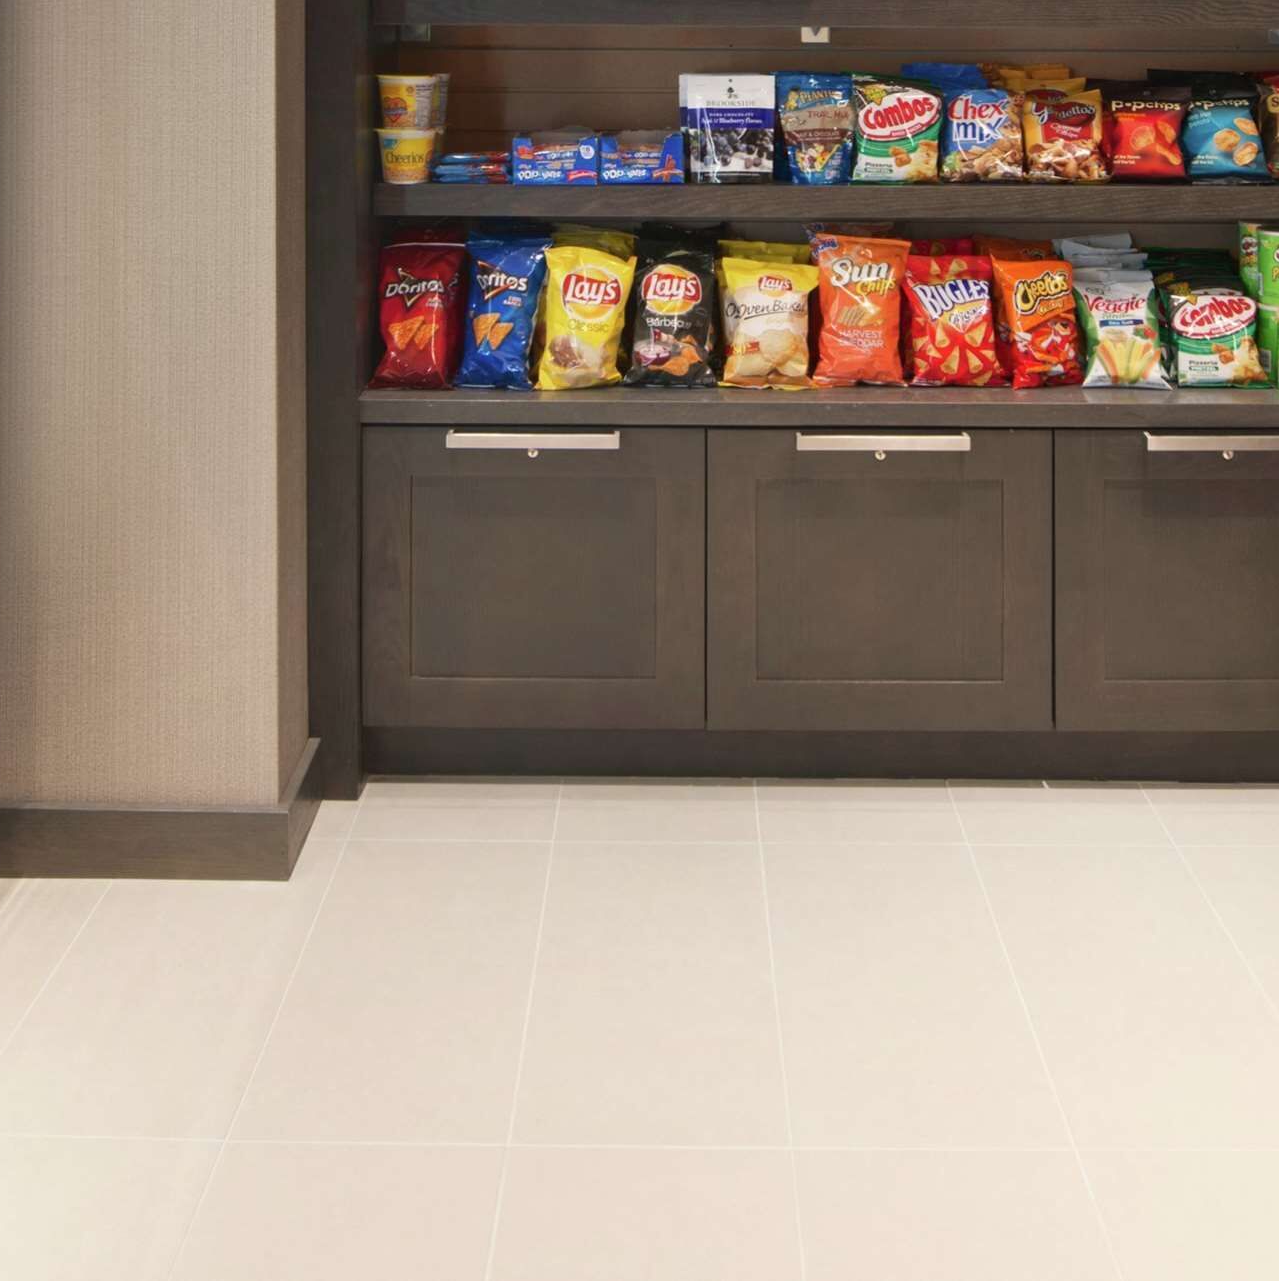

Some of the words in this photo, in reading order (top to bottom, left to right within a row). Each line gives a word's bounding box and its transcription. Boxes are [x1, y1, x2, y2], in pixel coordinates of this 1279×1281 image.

[863, 94, 935, 130] Combos
[948, 95, 1008, 121] Chex
[385, 150, 425, 166] Cheerios
[476, 273, 529, 292] Doritos
[831, 258, 889, 286] Sun
[384, 279, 445, 298] Doritos
[565, 274, 620, 304] Lay's
[647, 271, 699, 301] Lay's
[914, 278, 990, 320] BUGLES
[1015, 271, 1069, 312] Cheetos
[1084, 293, 1146, 315] Veggie
[567, 319, 610, 333] Classic
